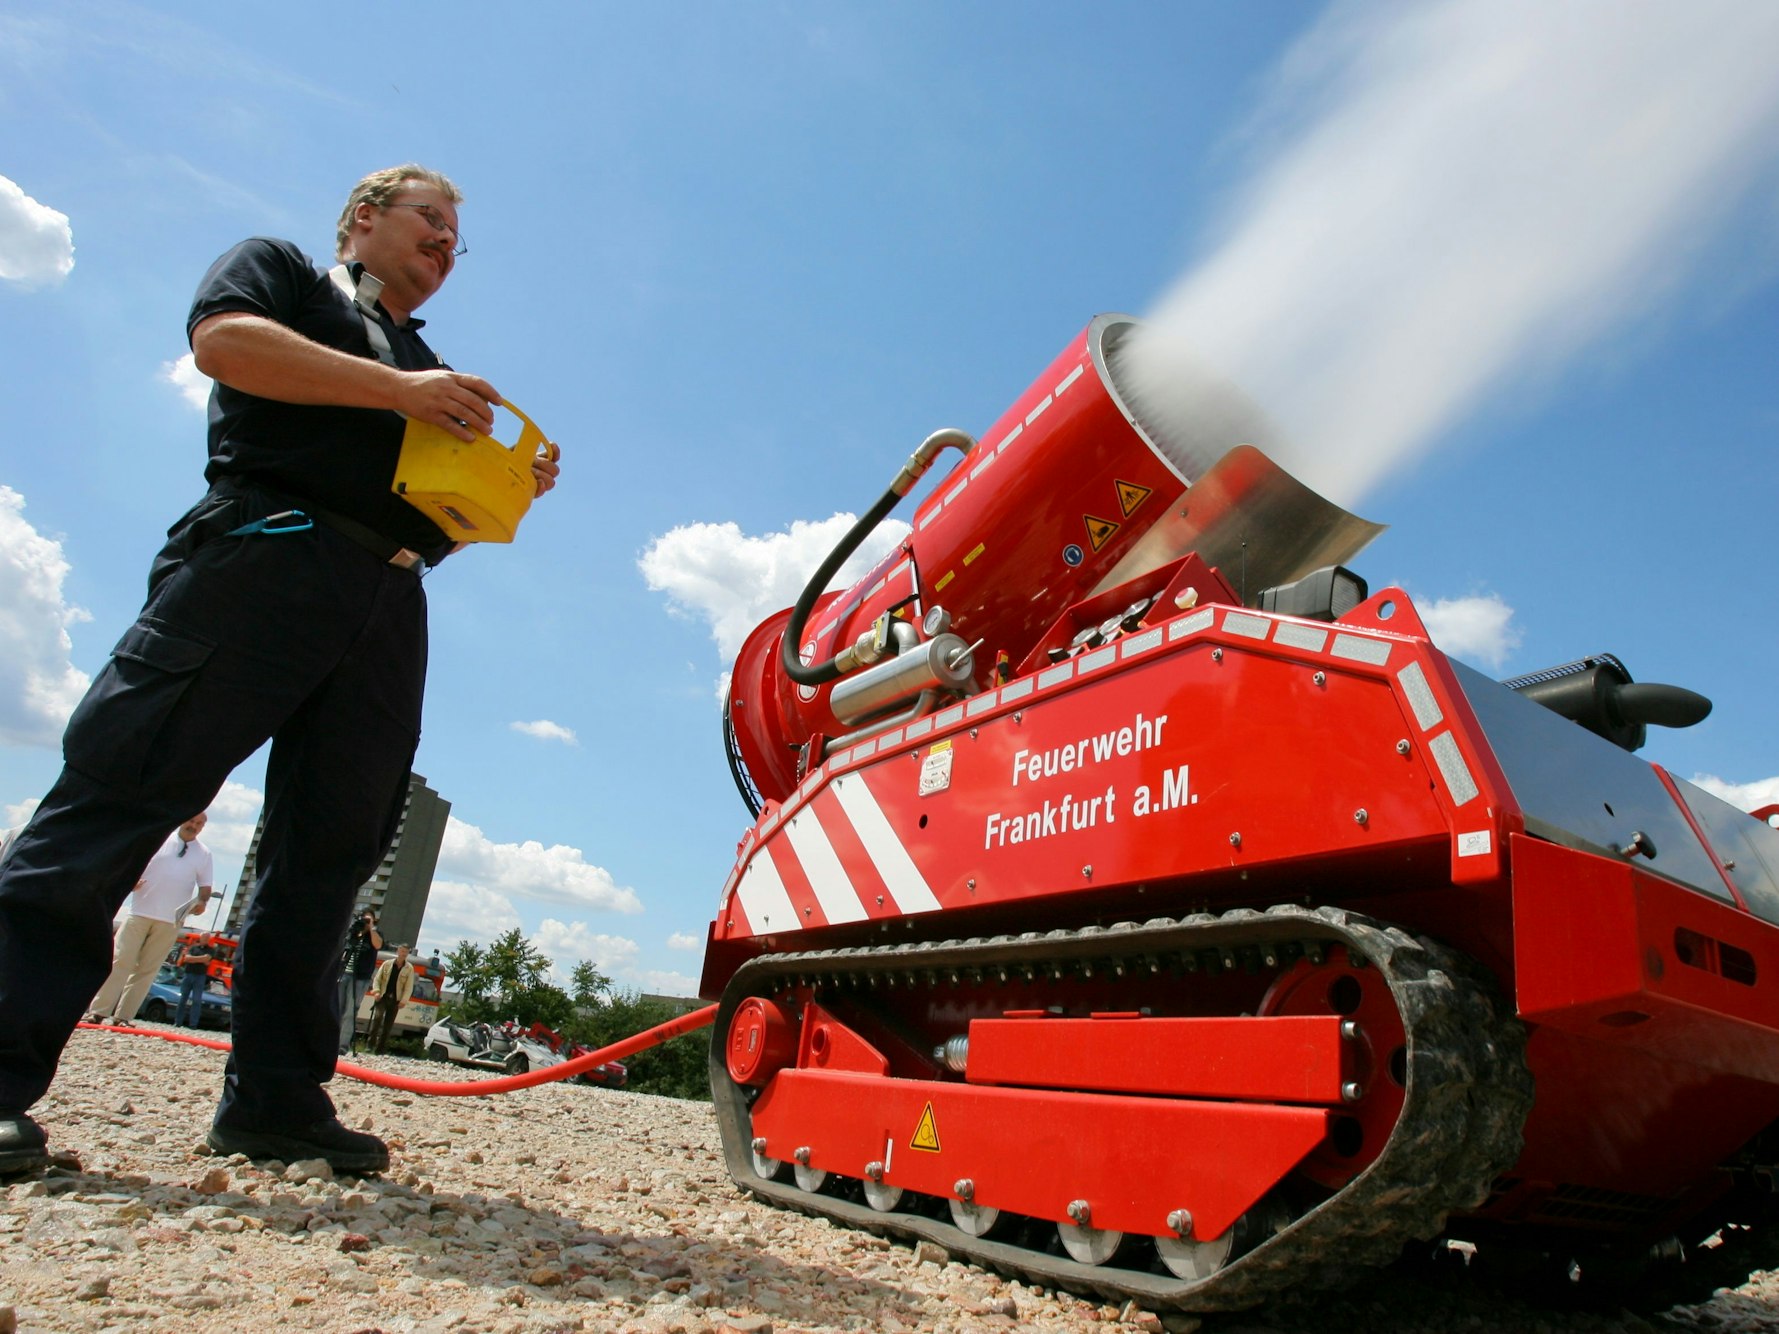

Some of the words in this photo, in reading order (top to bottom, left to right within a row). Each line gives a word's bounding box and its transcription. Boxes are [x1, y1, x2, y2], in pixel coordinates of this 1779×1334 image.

[1012, 713, 1168, 786] Feuerwehr
[985, 785, 1115, 849] Frankfurt
[1133, 764, 1198, 817] a.M.
